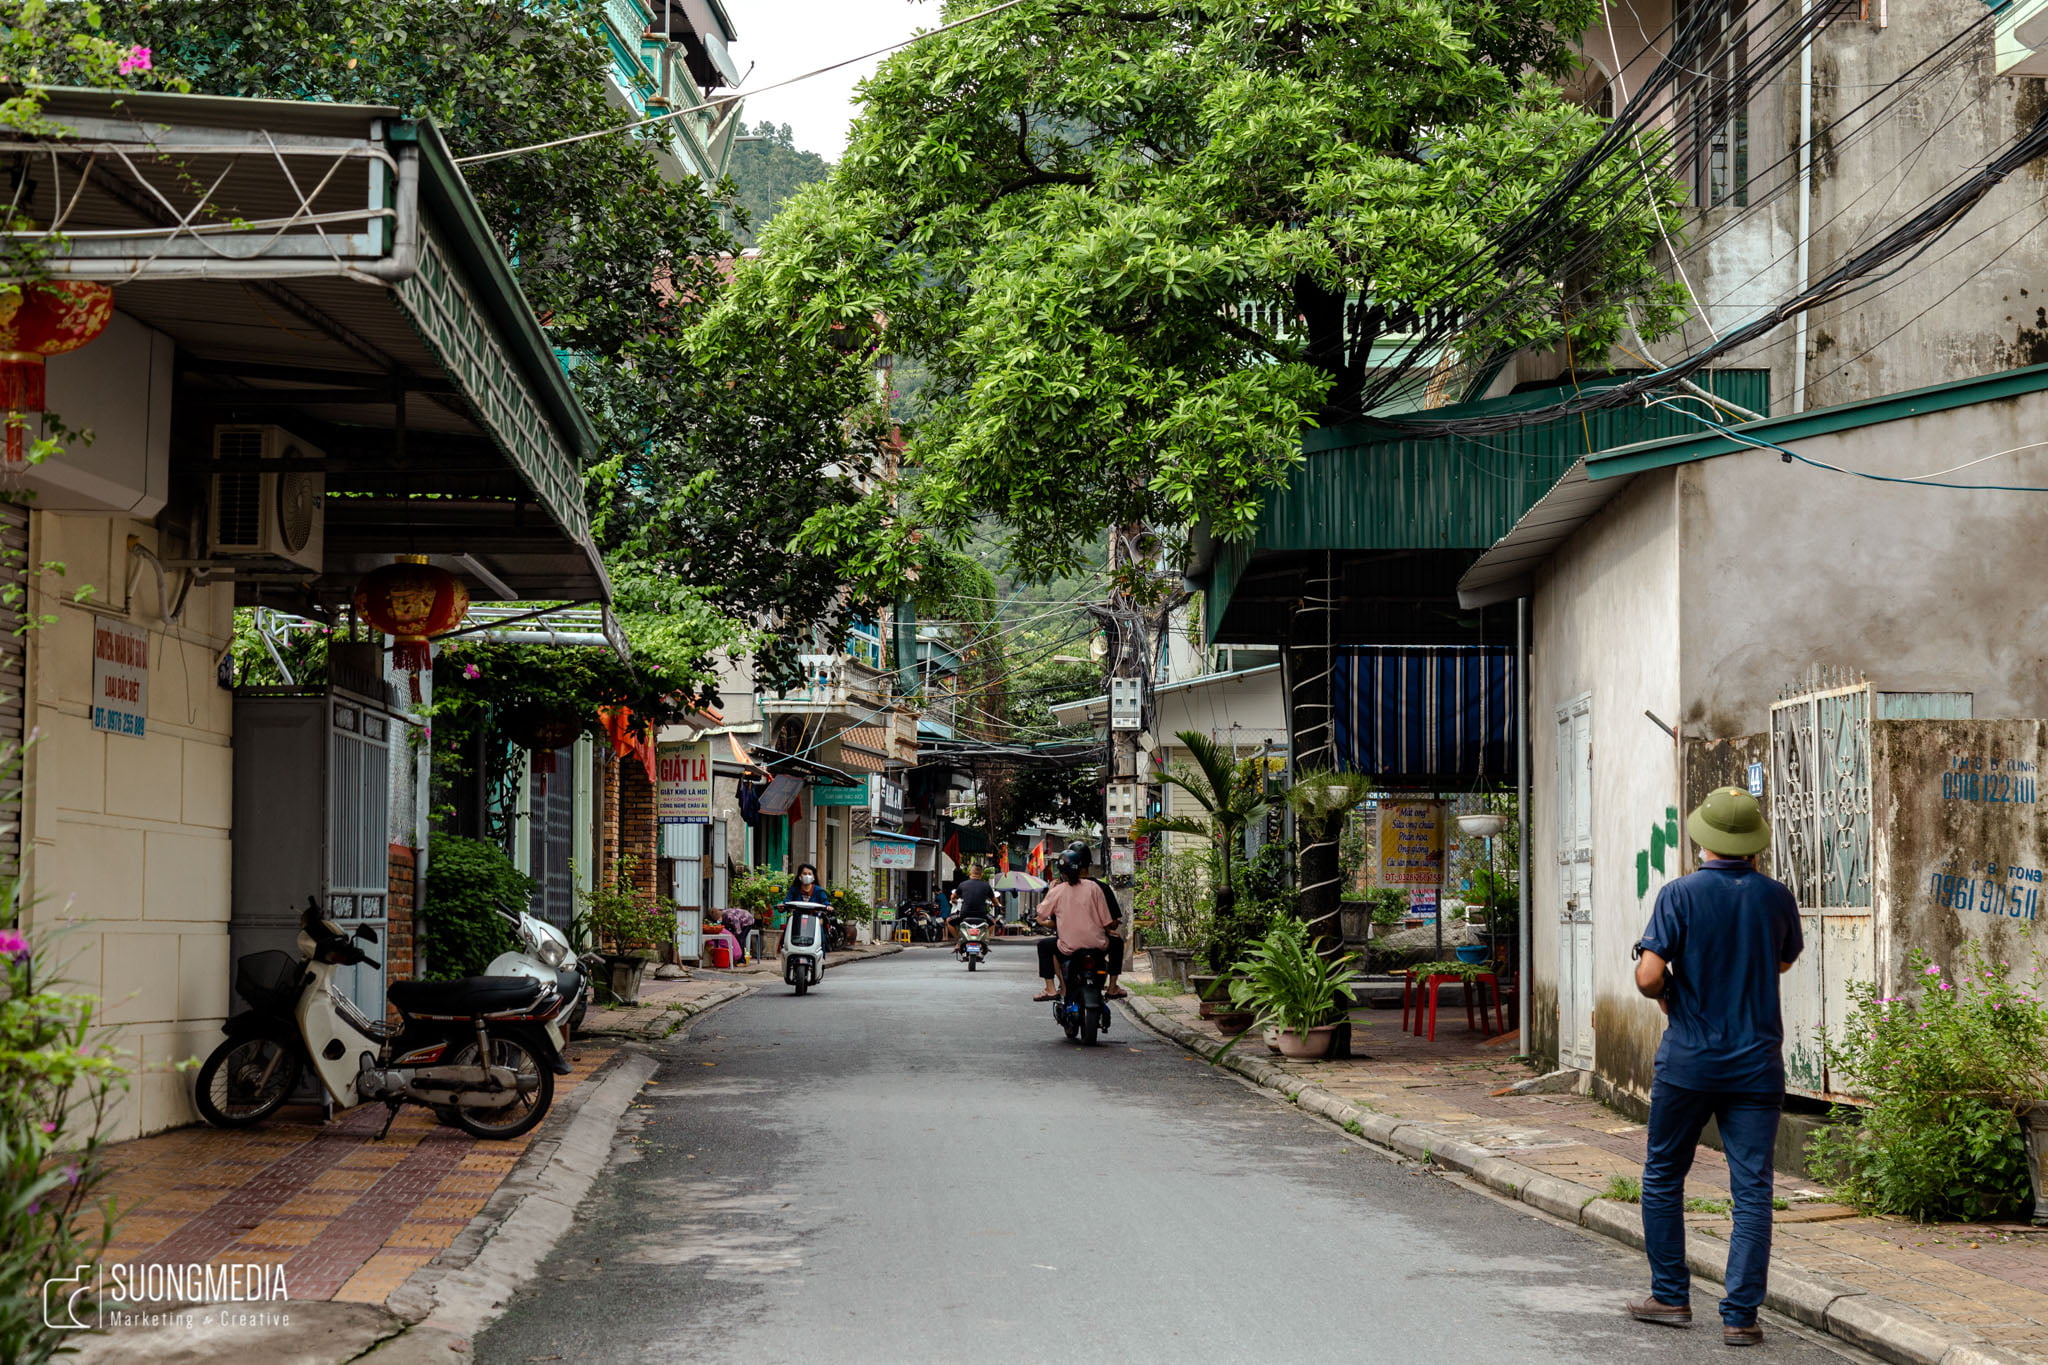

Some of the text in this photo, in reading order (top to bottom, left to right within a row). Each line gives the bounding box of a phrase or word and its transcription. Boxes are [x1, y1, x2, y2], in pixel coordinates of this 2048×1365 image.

[660, 754, 707, 788] GIẶT LÀ
[1750, 767, 1760, 792] 44
[1943, 771, 1980, 801] 0916
[1983, 773, 2011, 803] 122
[1987, 862, 1997, 874] B
[1980, 880, 2007, 915] 911
[2009, 885, 2038, 920] 511
